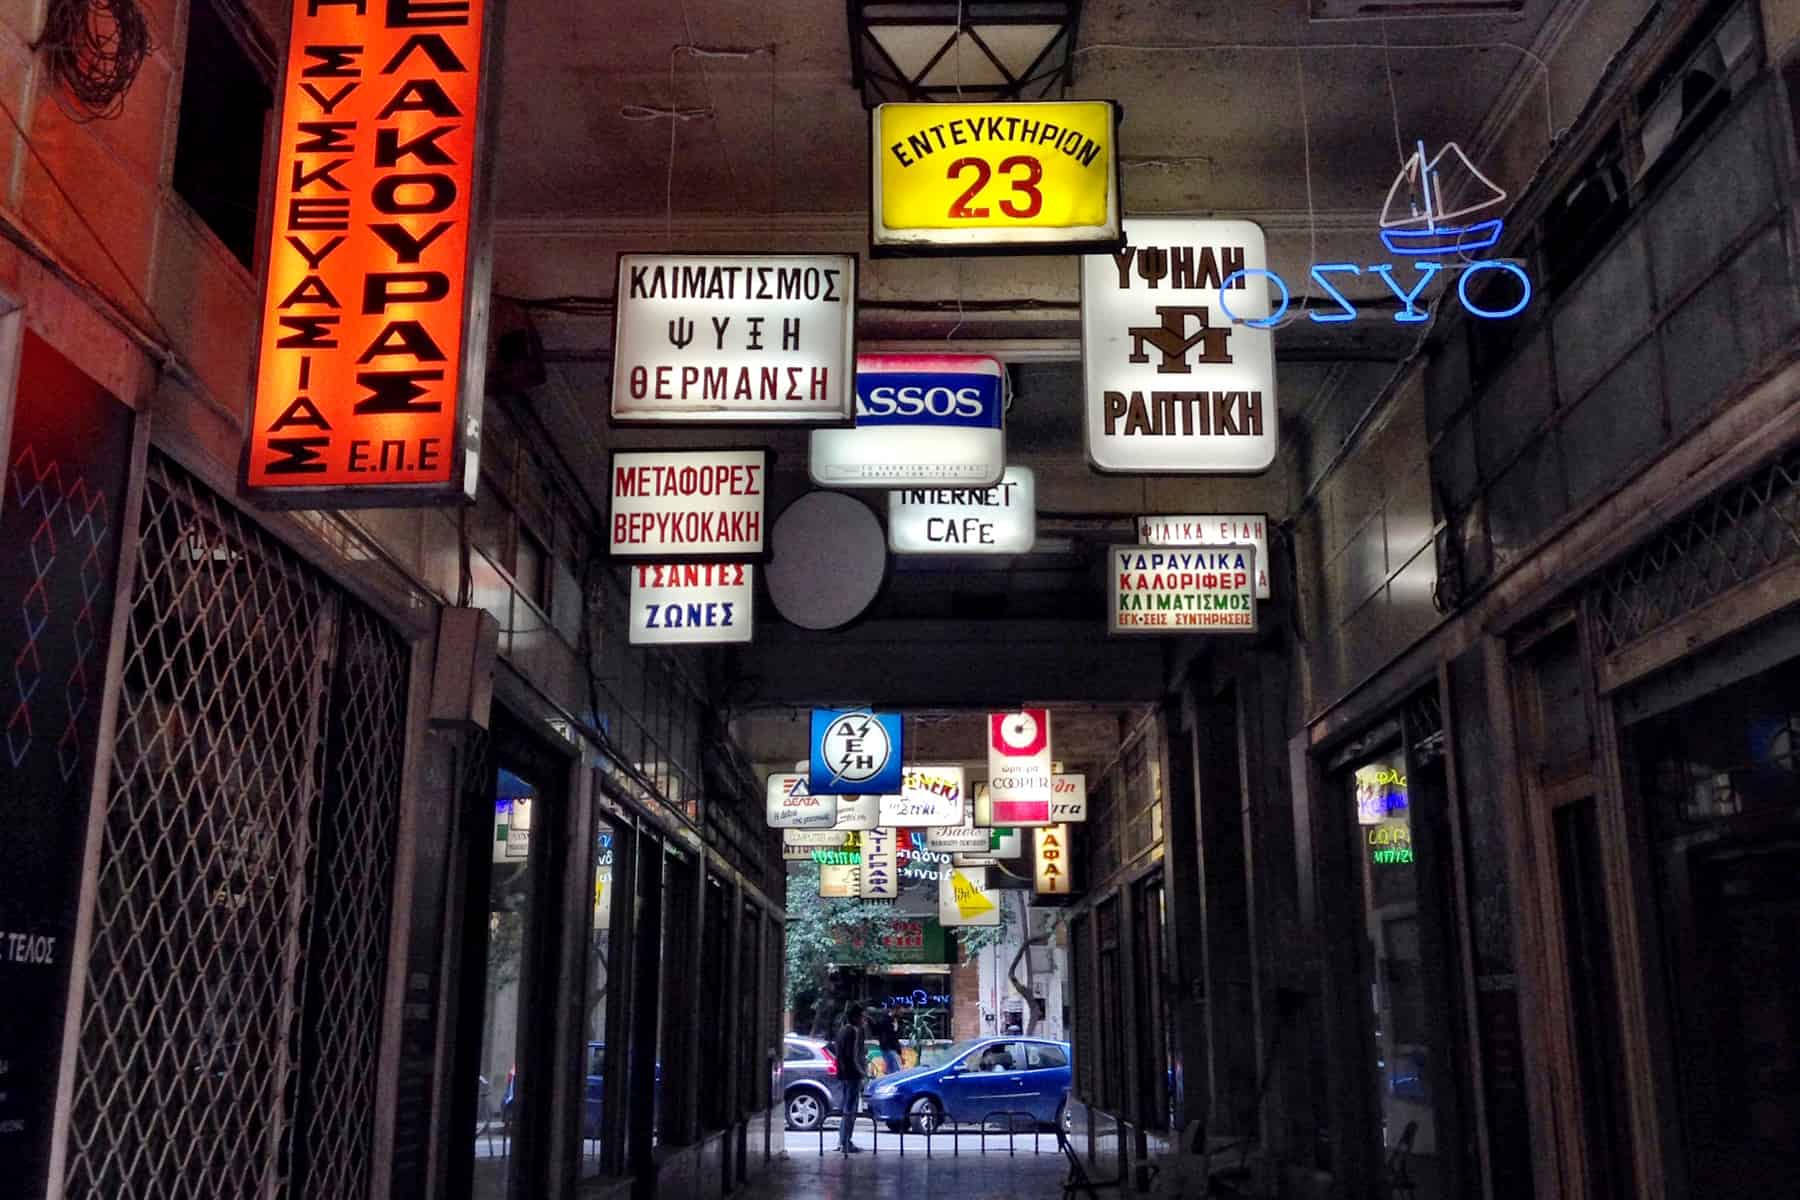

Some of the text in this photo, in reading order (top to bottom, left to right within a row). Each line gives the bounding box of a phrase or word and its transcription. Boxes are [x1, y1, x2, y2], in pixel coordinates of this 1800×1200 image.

[890, 116, 1101, 168] ΕΝΤΕΥΚΤΗΡΙΟΝ
[946, 155, 1043, 219] 23
[264, 45, 364, 475] ΣΥΣΚΕΥΑΣΙΑΣ
[1112, 246, 1246, 289] ΥΨΗΛΗ
[630, 265, 840, 302] ΚΛΙΜΑΤΙΣΜΟΣ
[668, 316, 801, 350] ΨΥΞΗ
[630, 366, 828, 401] ΘΕΡΜΑΝΣΗ
[1104, 391, 1264, 436] ΡΑΠΤΙΚΗ
[615, 465, 760, 497] ΜΕΤΑΦΟΡΕΣ
[613, 510, 760, 545] ΒΕΡΥΚΟΚΑΚΗ
[927, 517, 995, 544] CAFE
[1220, 520, 1263, 539] ΕΙΔΗ
[638, 563, 745, 589] ΤΣΑΝΤΕΣ
[1120, 553, 1246, 570] ΥΔΡΑΥΛΙΚΑ
[1119, 572, 1247, 590] ΚΑΛΟΡΙΦΕΡ
[645, 603, 734, 629] ΖΩΝΕΣ
[1119, 593, 1250, 611] ΚΛΙΜΑΤΙΣΜΟΣ
[7, 931, 57, 966] ΤΕΛΟΣ
